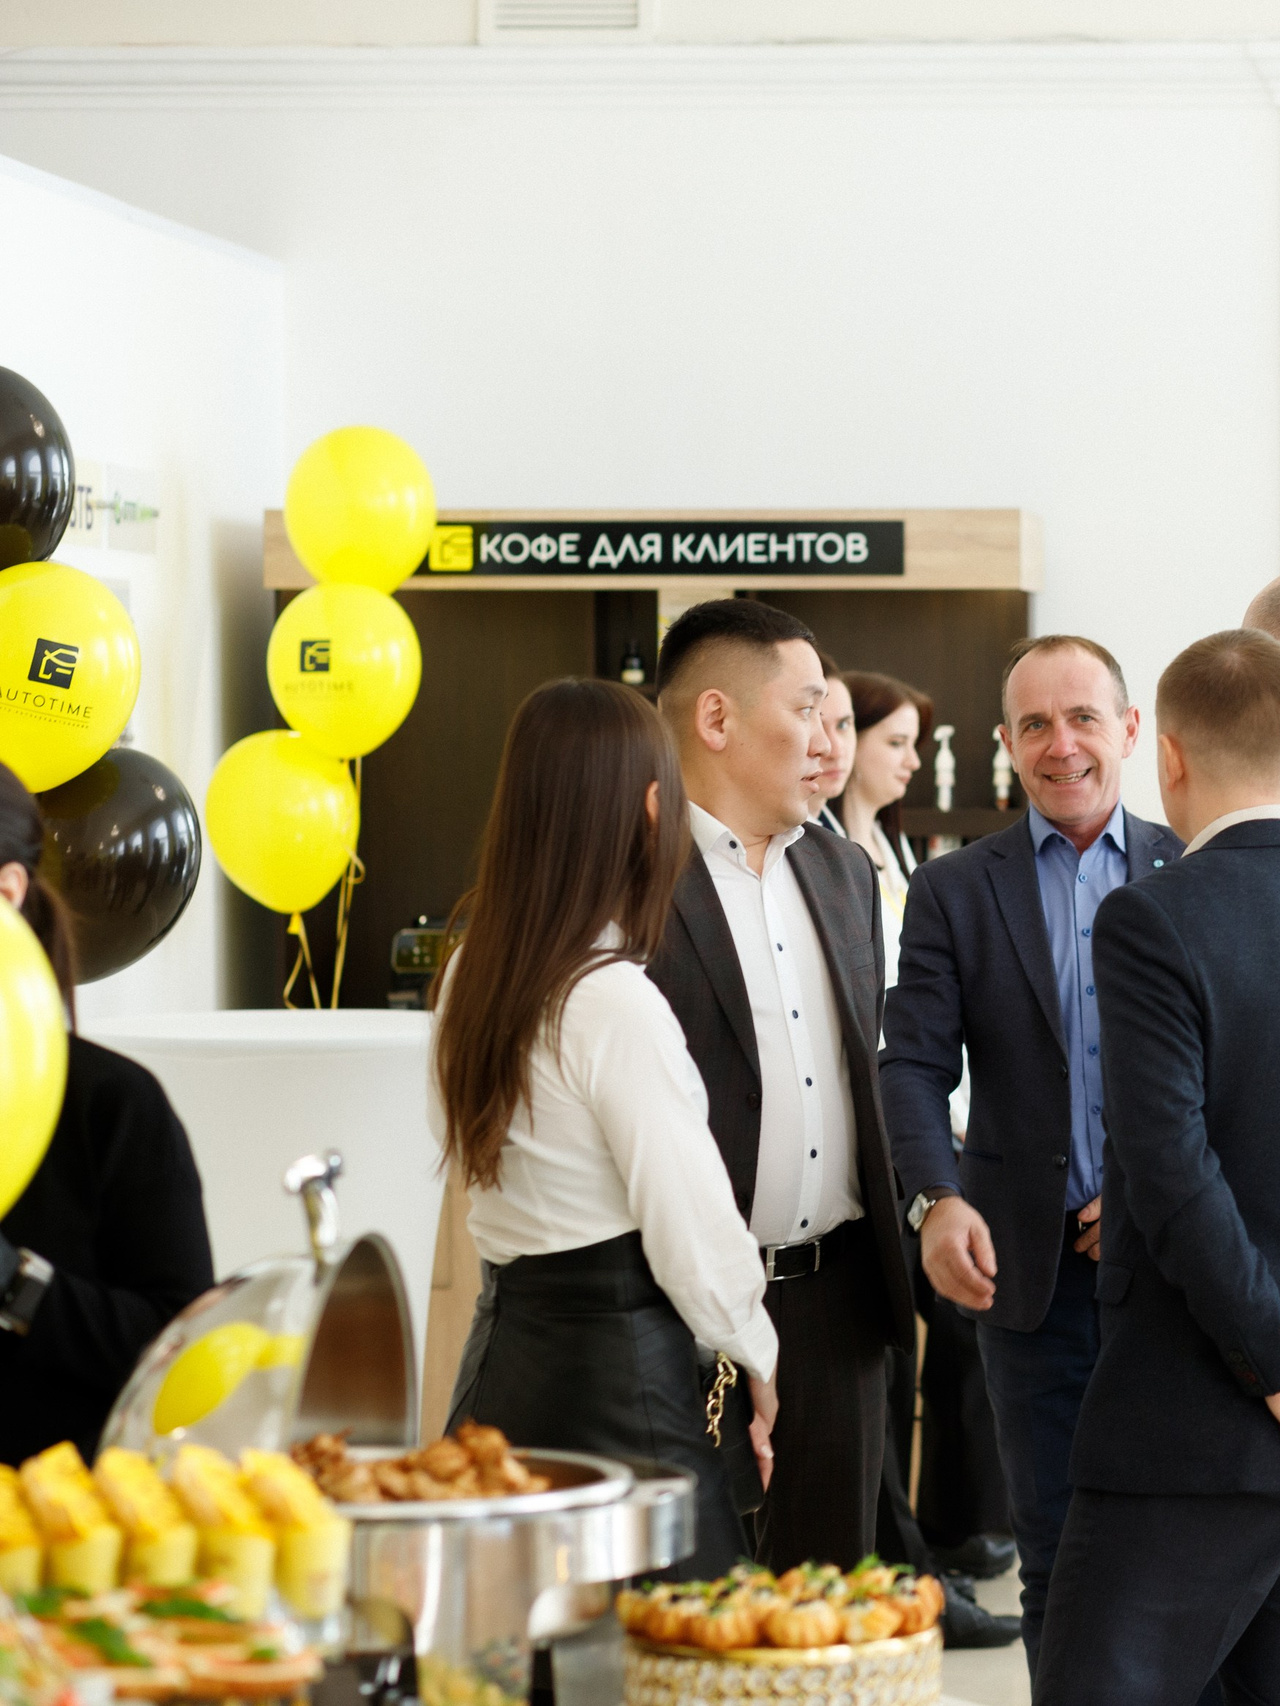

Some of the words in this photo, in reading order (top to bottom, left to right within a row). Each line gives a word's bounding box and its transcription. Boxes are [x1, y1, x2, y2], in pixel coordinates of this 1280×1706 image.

[479, 532, 582, 565] КОФЕ
[588, 532, 663, 570] ДЛЯ
[672, 532, 870, 565] КЛИЕНТОВ
